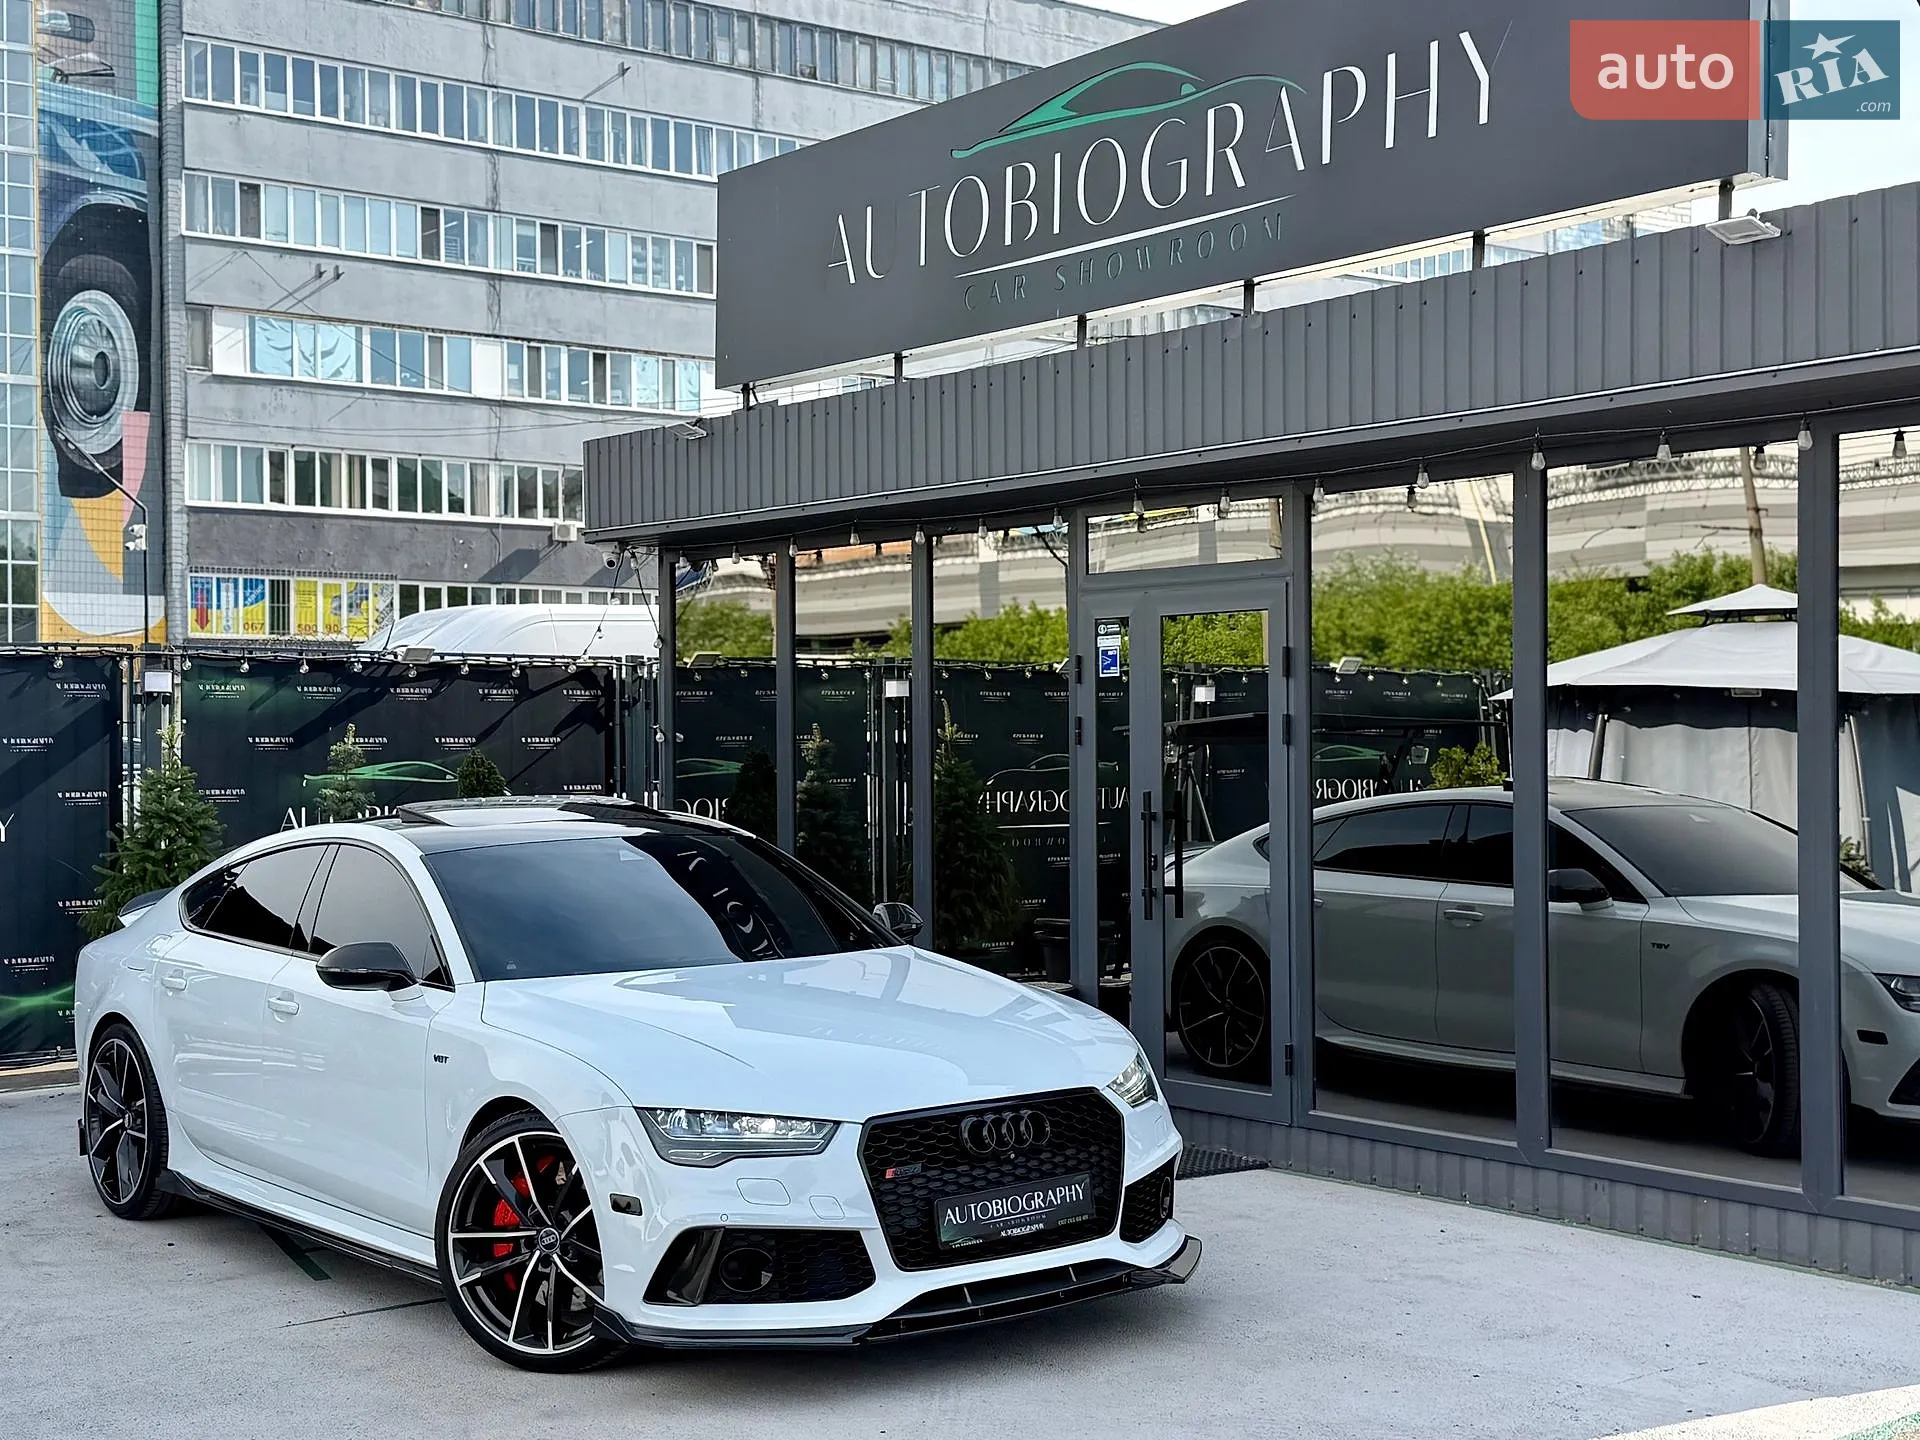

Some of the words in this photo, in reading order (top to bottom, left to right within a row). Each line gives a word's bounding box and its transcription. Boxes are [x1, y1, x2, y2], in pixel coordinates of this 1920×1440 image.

[827, 20, 1513, 286] AUTOBIOGRAPHY
[963, 274, 1027, 312] CAR
[1053, 211, 1283, 292] SHOWROOM
[943, 1182, 1086, 1227] AUTOBIOGRAPHY
